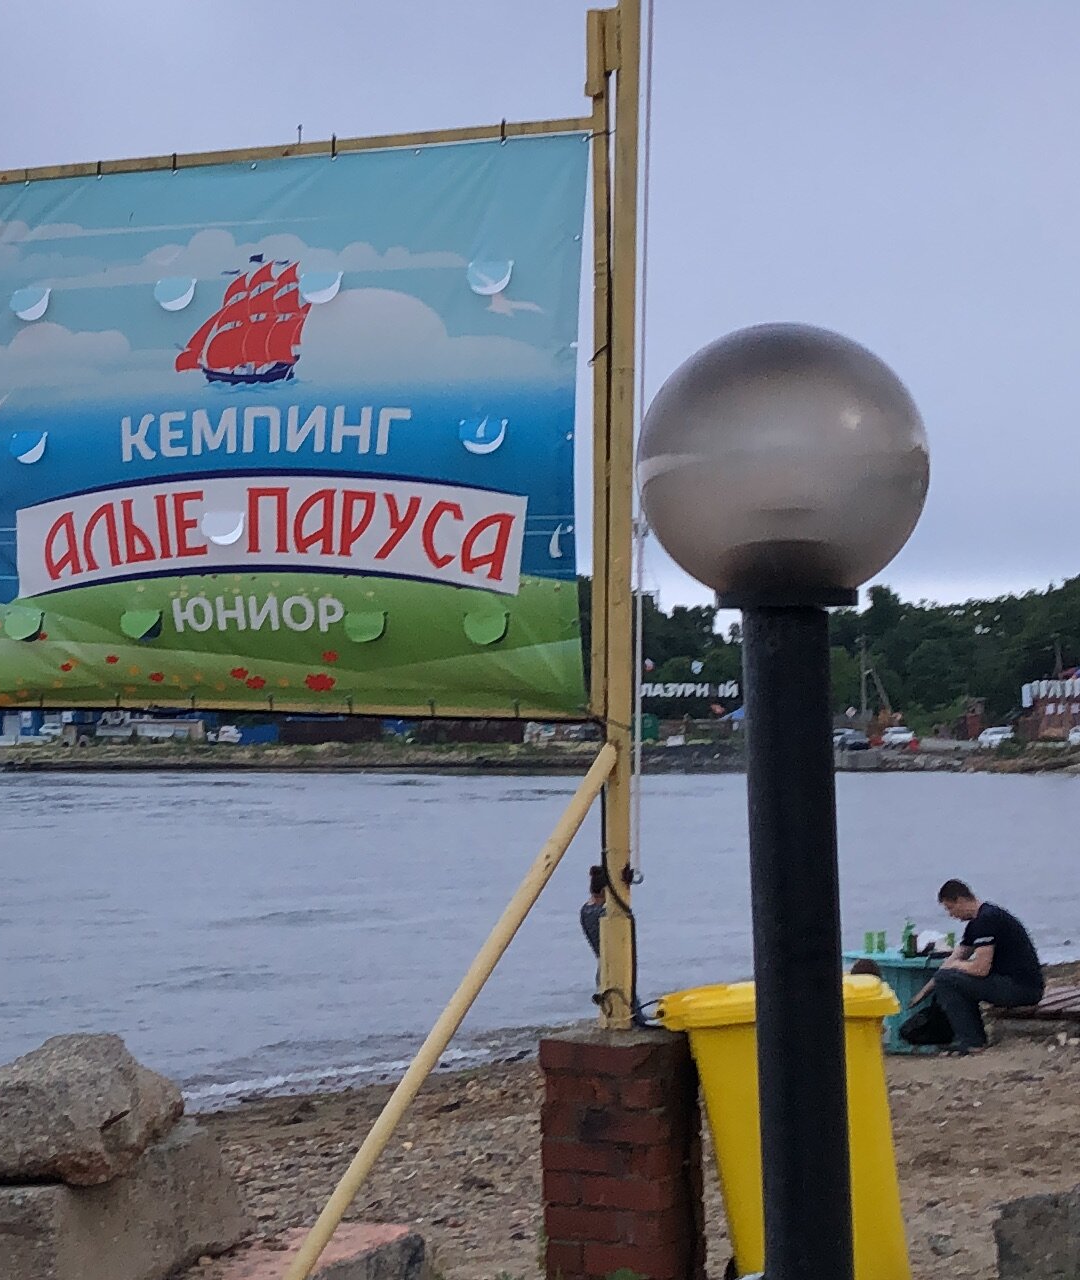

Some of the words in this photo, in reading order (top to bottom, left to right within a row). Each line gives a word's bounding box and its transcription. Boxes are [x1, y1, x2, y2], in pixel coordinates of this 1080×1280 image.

[121, 406, 412, 462] КЕМПИНГ
[44, 491, 208, 580] АЛЫЕ
[246, 488, 517, 581] ПАРУСА
[172, 595, 345, 633] ЮНИОР
